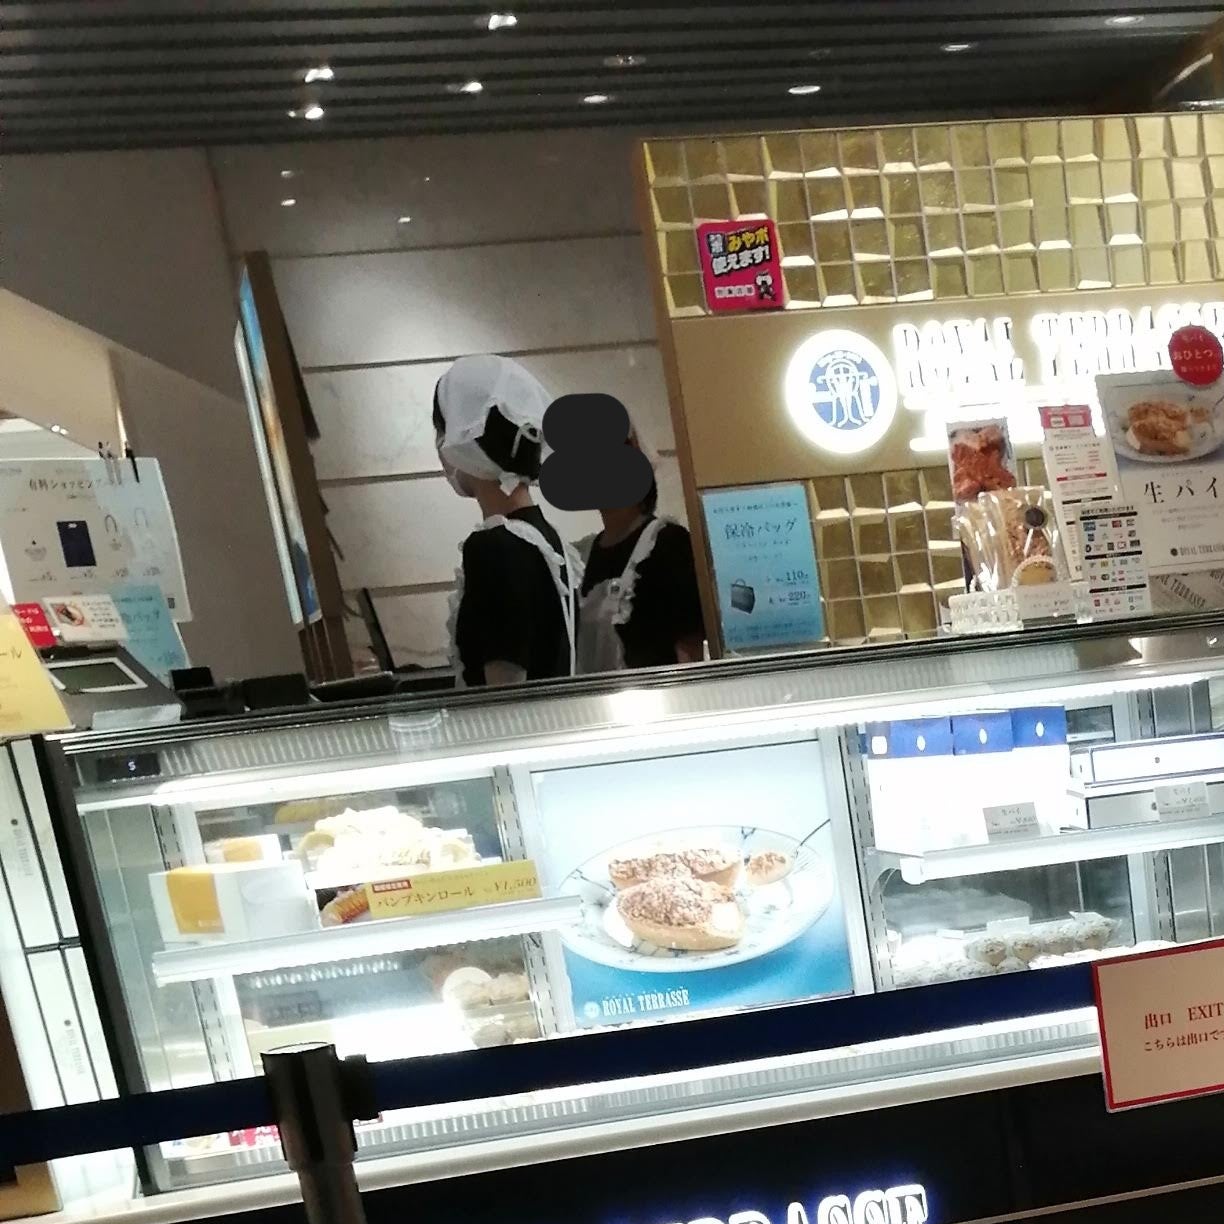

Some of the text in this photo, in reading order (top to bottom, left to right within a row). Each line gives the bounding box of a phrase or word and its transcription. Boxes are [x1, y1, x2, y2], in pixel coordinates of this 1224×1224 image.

[1144, 476, 1219, 504] 生パイ
[602, 988, 690, 1016] ROYAL TERRASSE
[1144, 1001, 1224, 1030] 出口 EXIT
